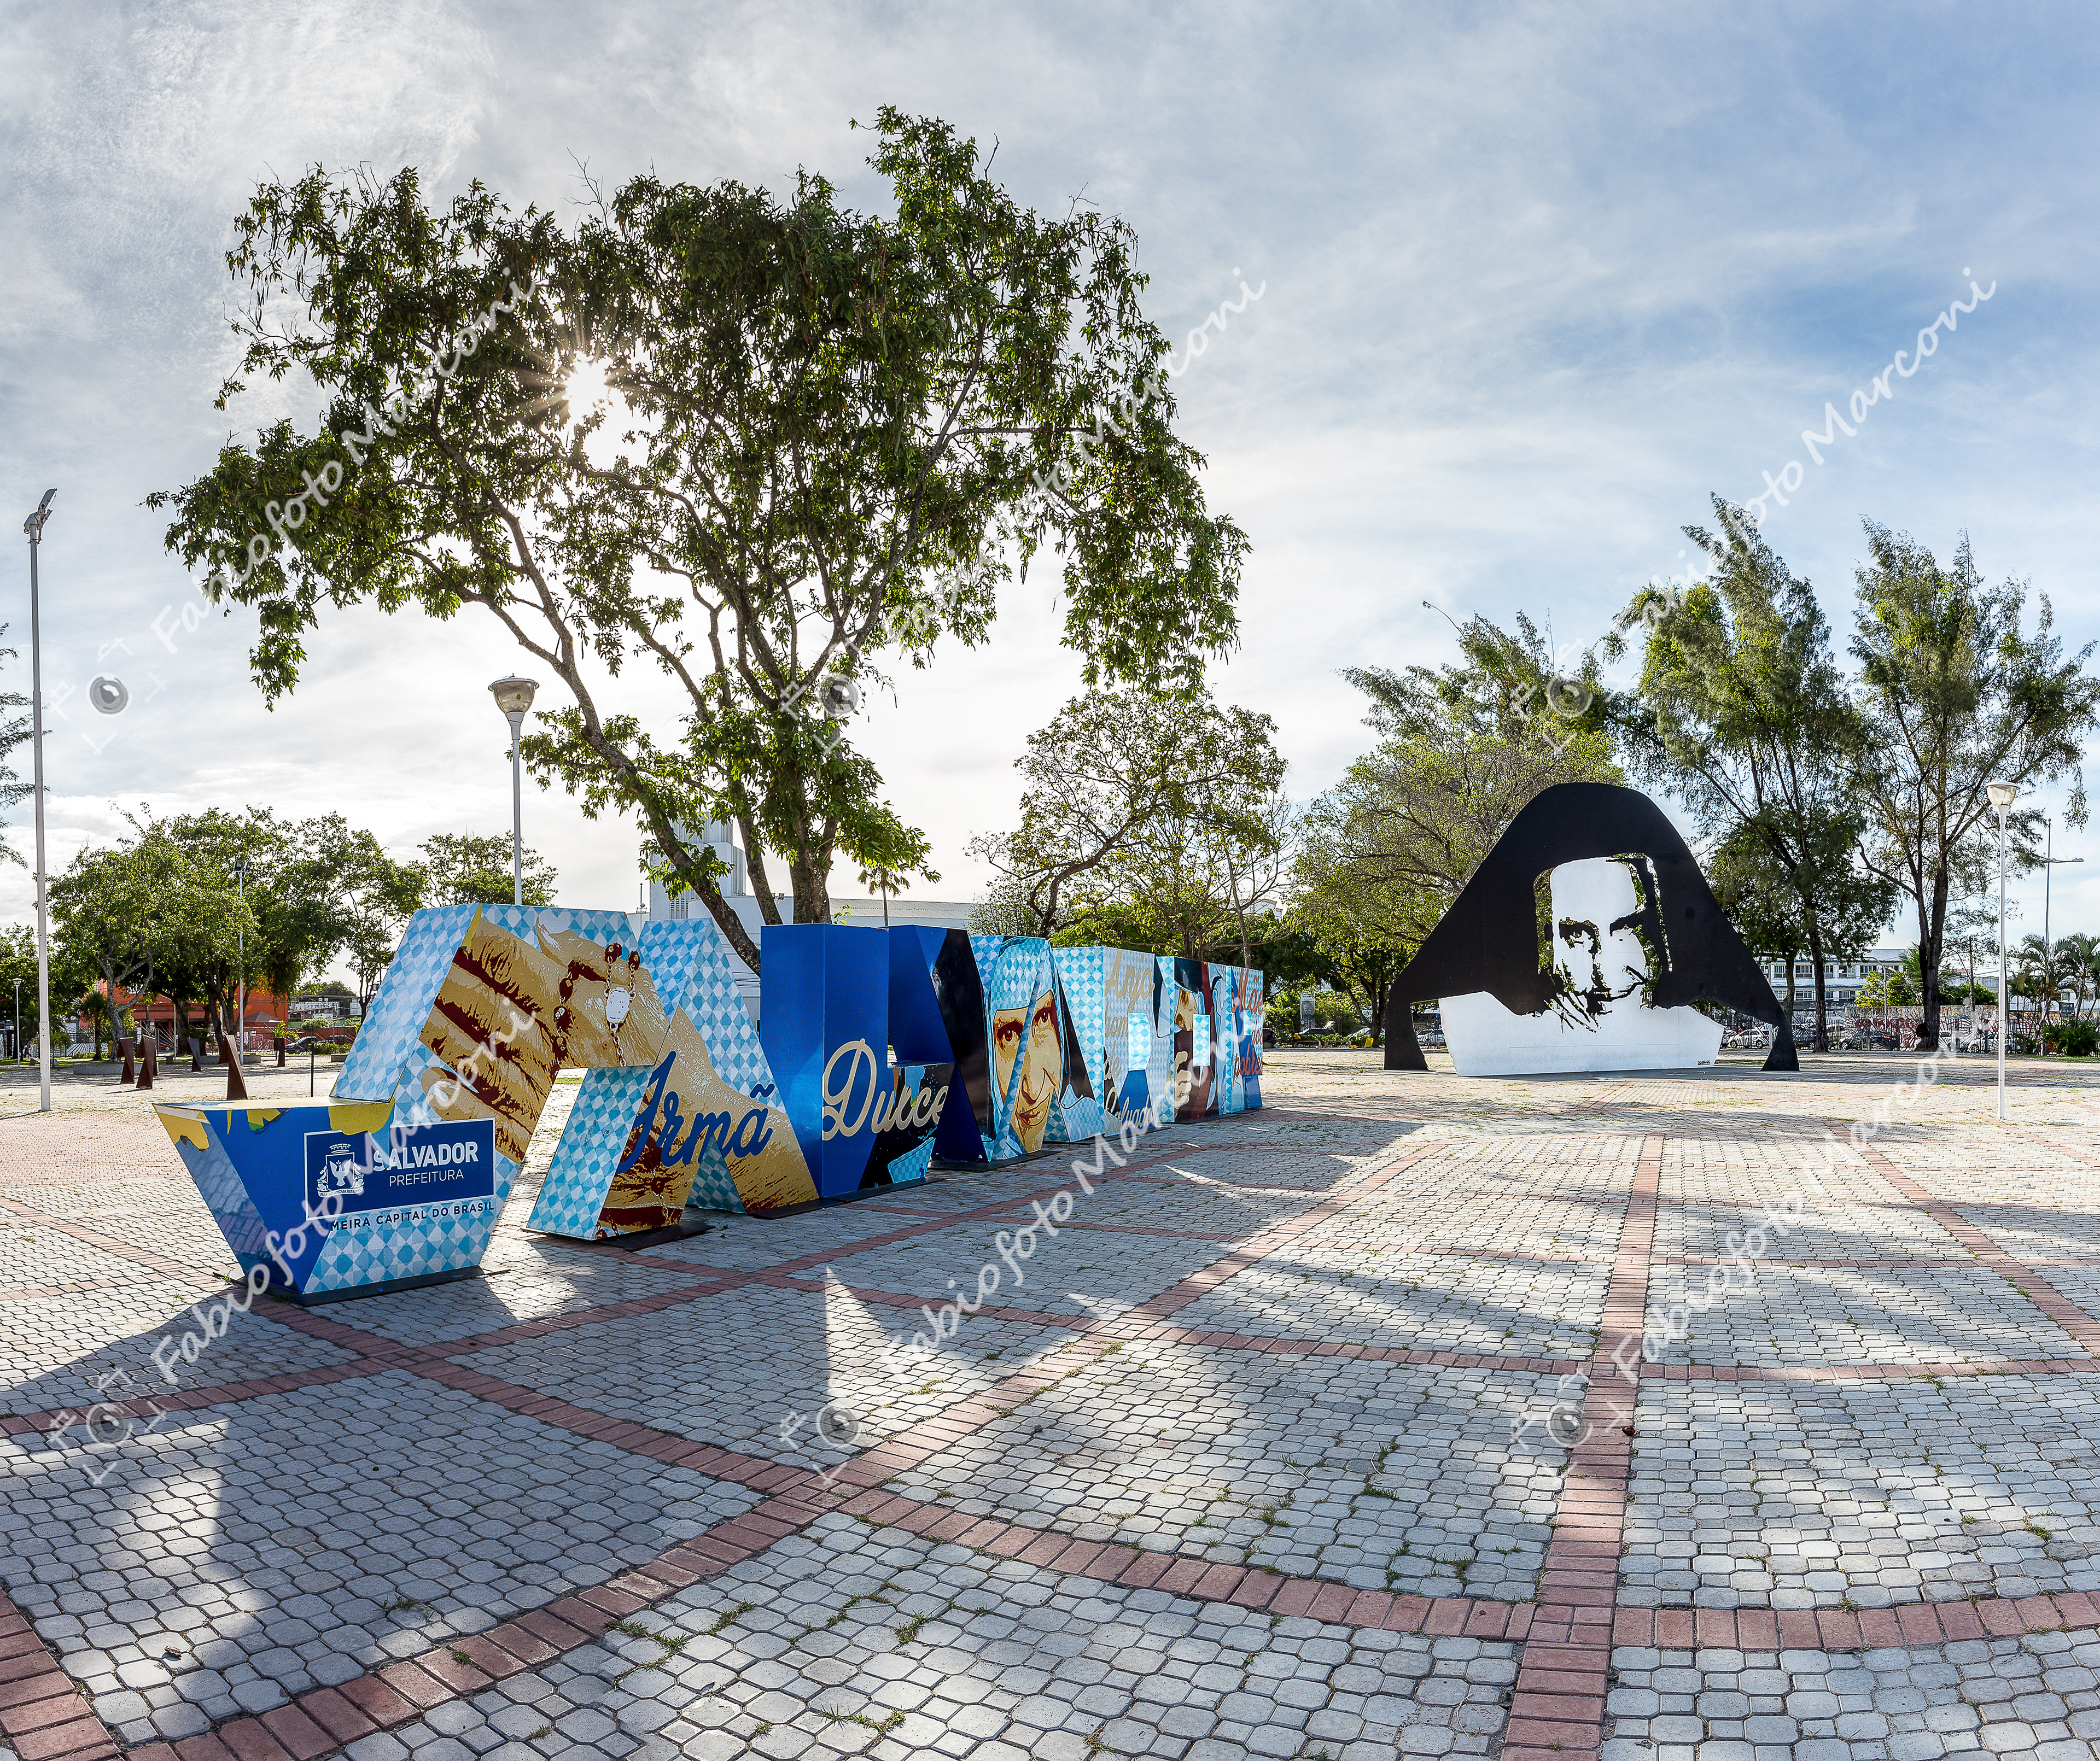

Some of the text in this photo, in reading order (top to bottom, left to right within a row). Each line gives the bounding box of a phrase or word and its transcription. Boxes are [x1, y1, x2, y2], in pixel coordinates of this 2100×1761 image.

[1104, 950, 1155, 1016] Anjo
[1231, 968, 1263, 1015] Mãe
[1104, 1001, 1129, 1038] bom
[1104, 1040, 1121, 1080] de
[615, 1038, 949, 1174] Irmã Dulce
[1104, 1086, 1159, 1134] Salvador
[373, 1141, 479, 1172] SALVADOR
[389, 1168, 464, 1187] PREFEITURA
[308, 1202, 494, 1235] PIMEIRA CAPITAL DO BRASIL
